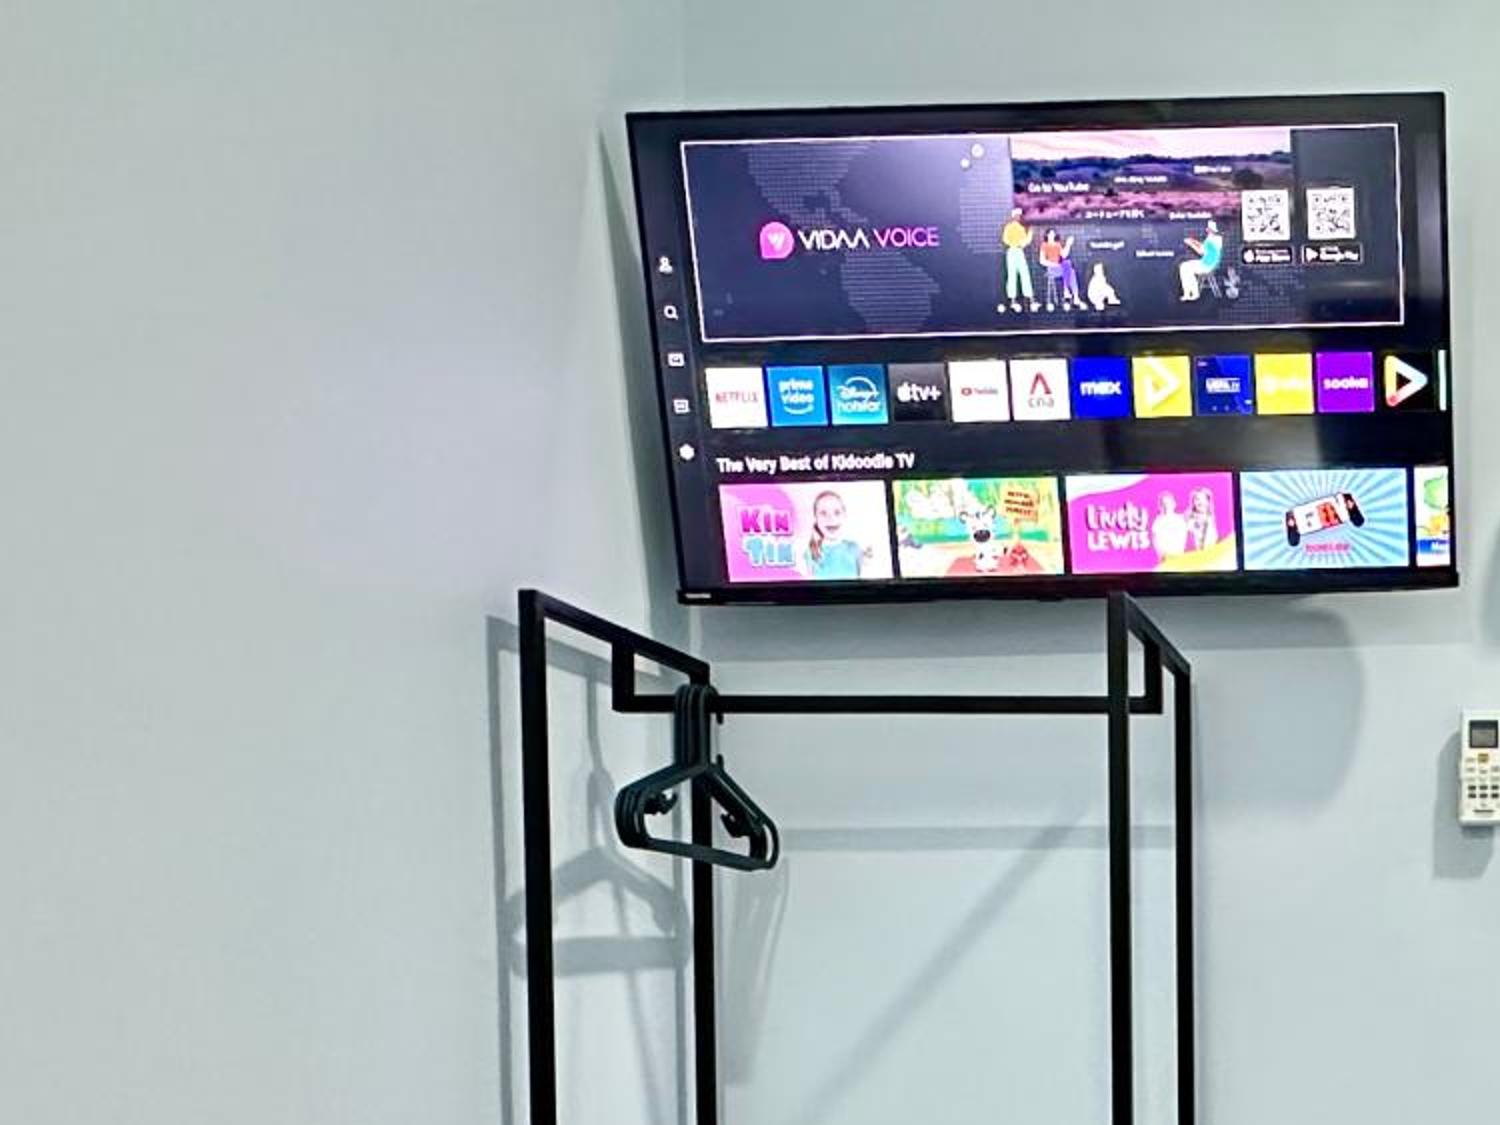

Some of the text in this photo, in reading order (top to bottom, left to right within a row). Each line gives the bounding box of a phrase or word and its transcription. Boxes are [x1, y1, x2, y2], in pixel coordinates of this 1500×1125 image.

[799, 227, 940, 250] VIDAA VOICE
[779, 378, 814, 392] prime
[1079, 379, 1122, 396] max
[714, 390, 759, 404] NETFLIX
[780, 391, 815, 404] video
[1028, 395, 1055, 408] cna
[717, 452, 915, 476] The Very Best of Kidoodle TV
[740, 508, 790, 534] KIN
[1087, 530, 1151, 551] LEWIS
